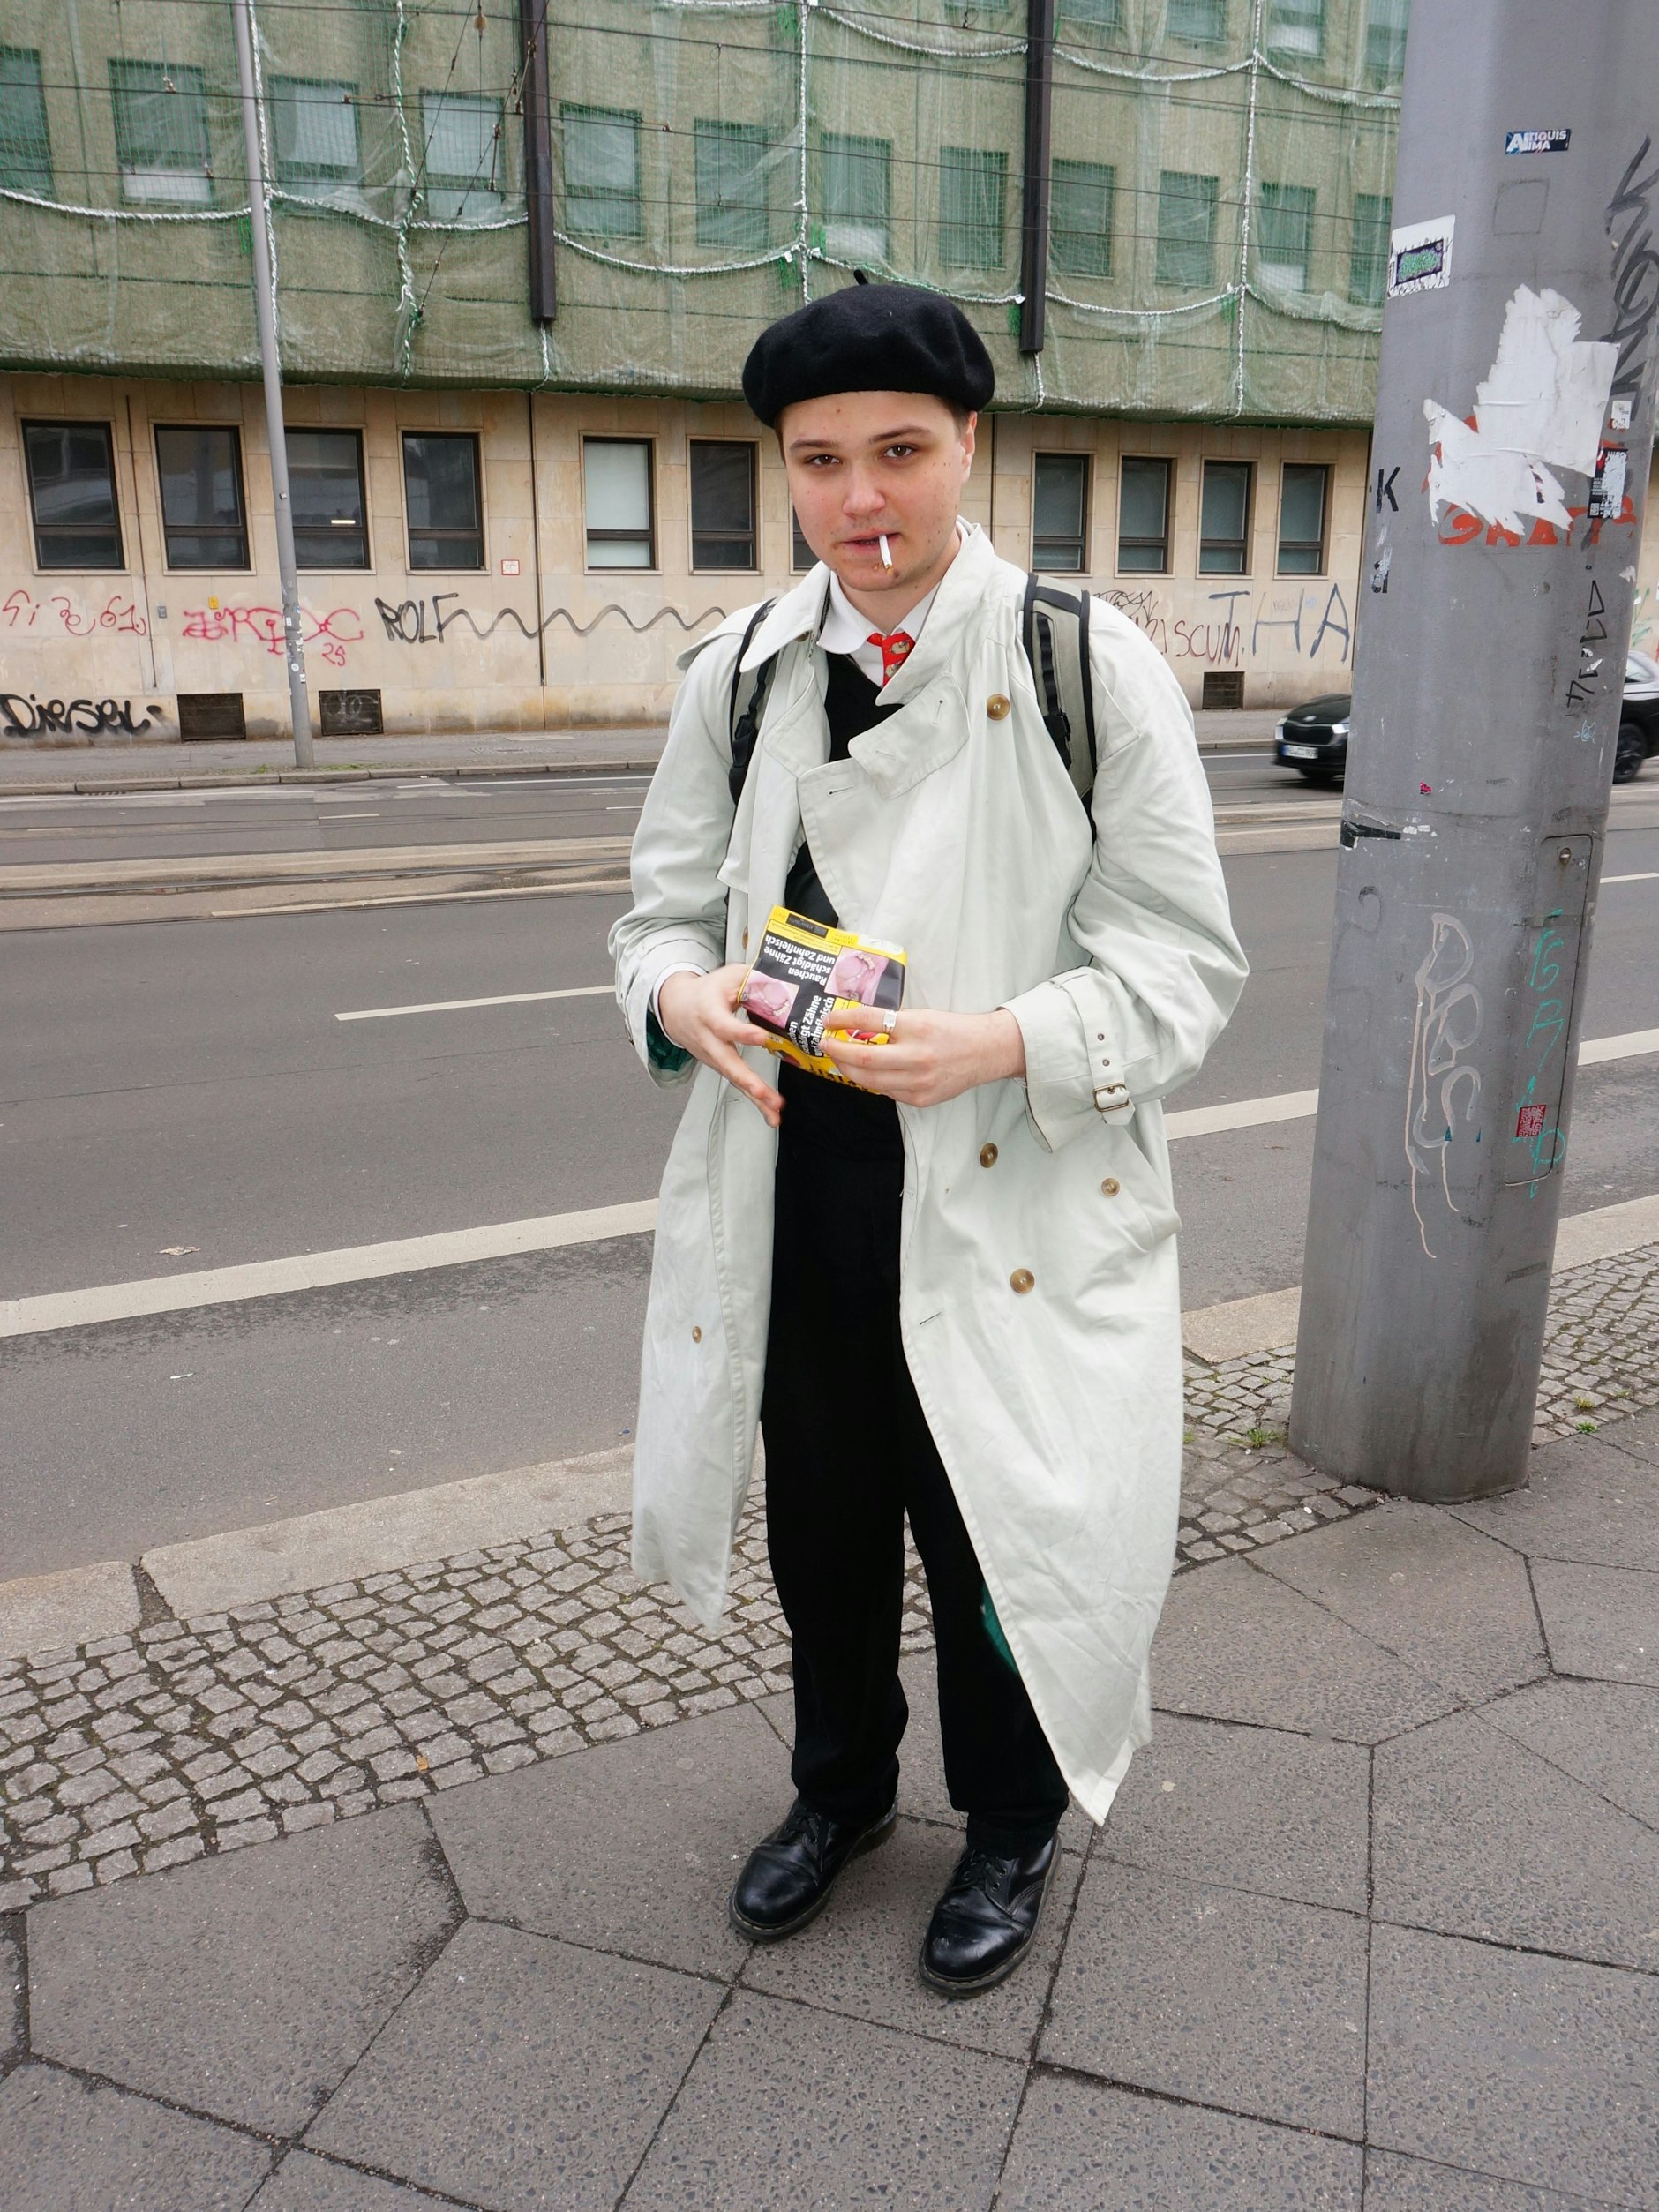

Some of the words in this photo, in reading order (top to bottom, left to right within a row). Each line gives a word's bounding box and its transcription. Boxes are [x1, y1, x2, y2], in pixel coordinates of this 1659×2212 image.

[374, 592, 459, 643] ROLF
[763, 946, 792, 964] Zähne
[765, 934, 816, 963] Zahnfleisch
[792, 956, 832, 973] schädigt
[815, 953, 836, 964] und
[788, 967, 827, 986] Rauchen
[802, 994, 822, 1027] Zähne
